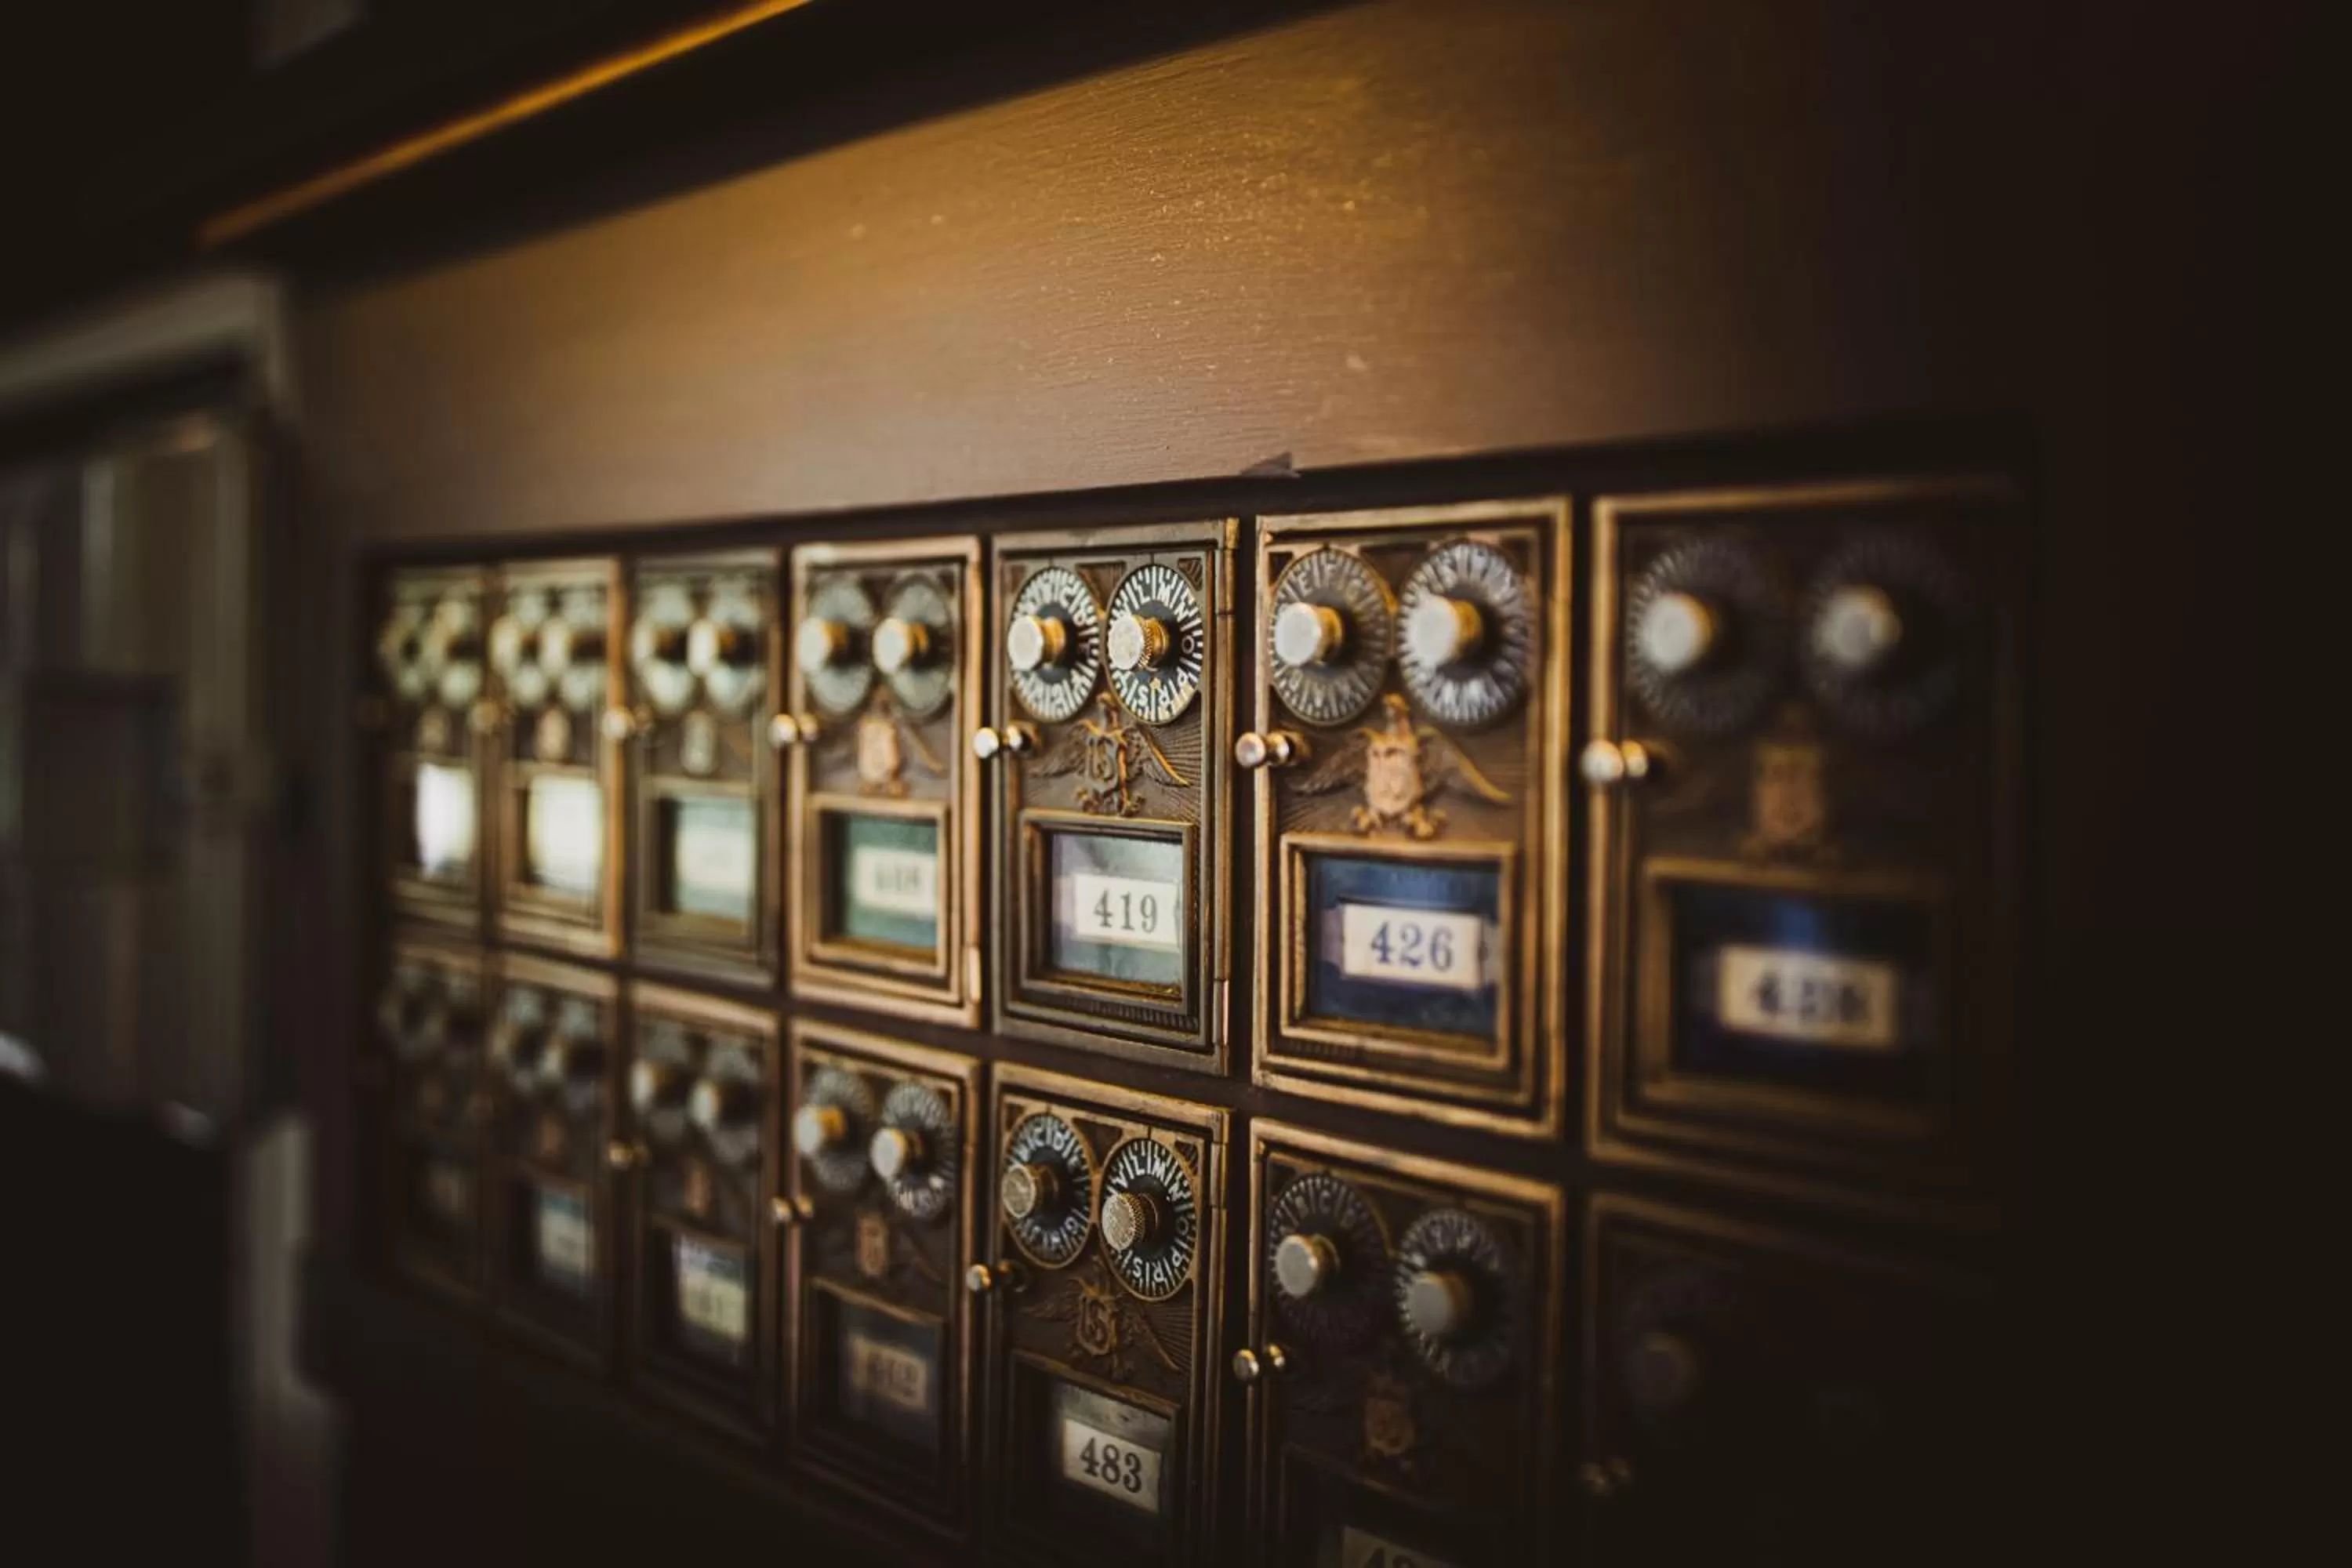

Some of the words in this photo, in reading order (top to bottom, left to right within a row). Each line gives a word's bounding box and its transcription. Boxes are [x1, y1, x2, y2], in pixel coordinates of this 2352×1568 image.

[1093, 889, 1158, 934] 419
[1370, 920, 1454, 974] 426
[1080, 1437, 1142, 1494] 483
